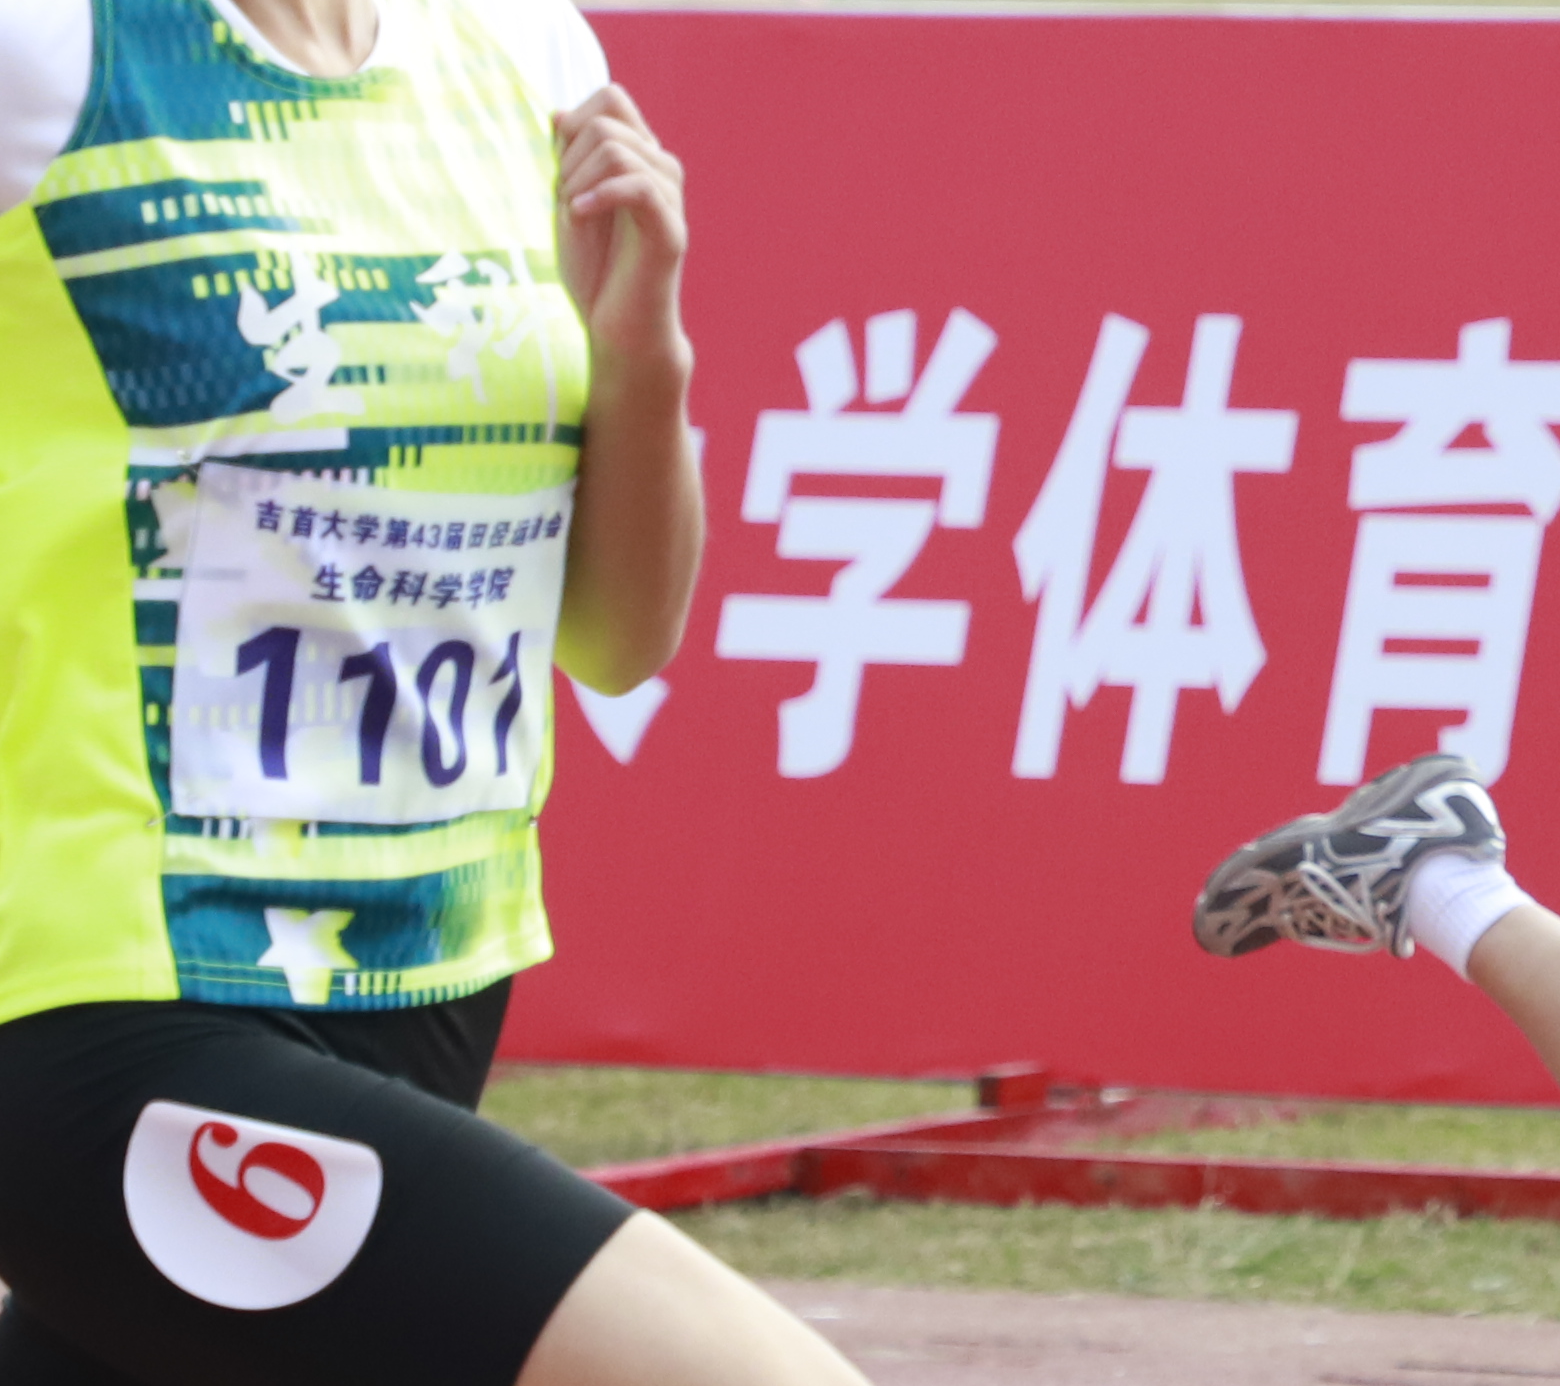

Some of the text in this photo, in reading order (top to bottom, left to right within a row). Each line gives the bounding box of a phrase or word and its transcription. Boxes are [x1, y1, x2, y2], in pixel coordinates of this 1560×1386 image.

[310, 563, 515, 611] 生命科学学院
[235, 626, 522, 789] 1101
[189, 1121, 325, 1241] 6
